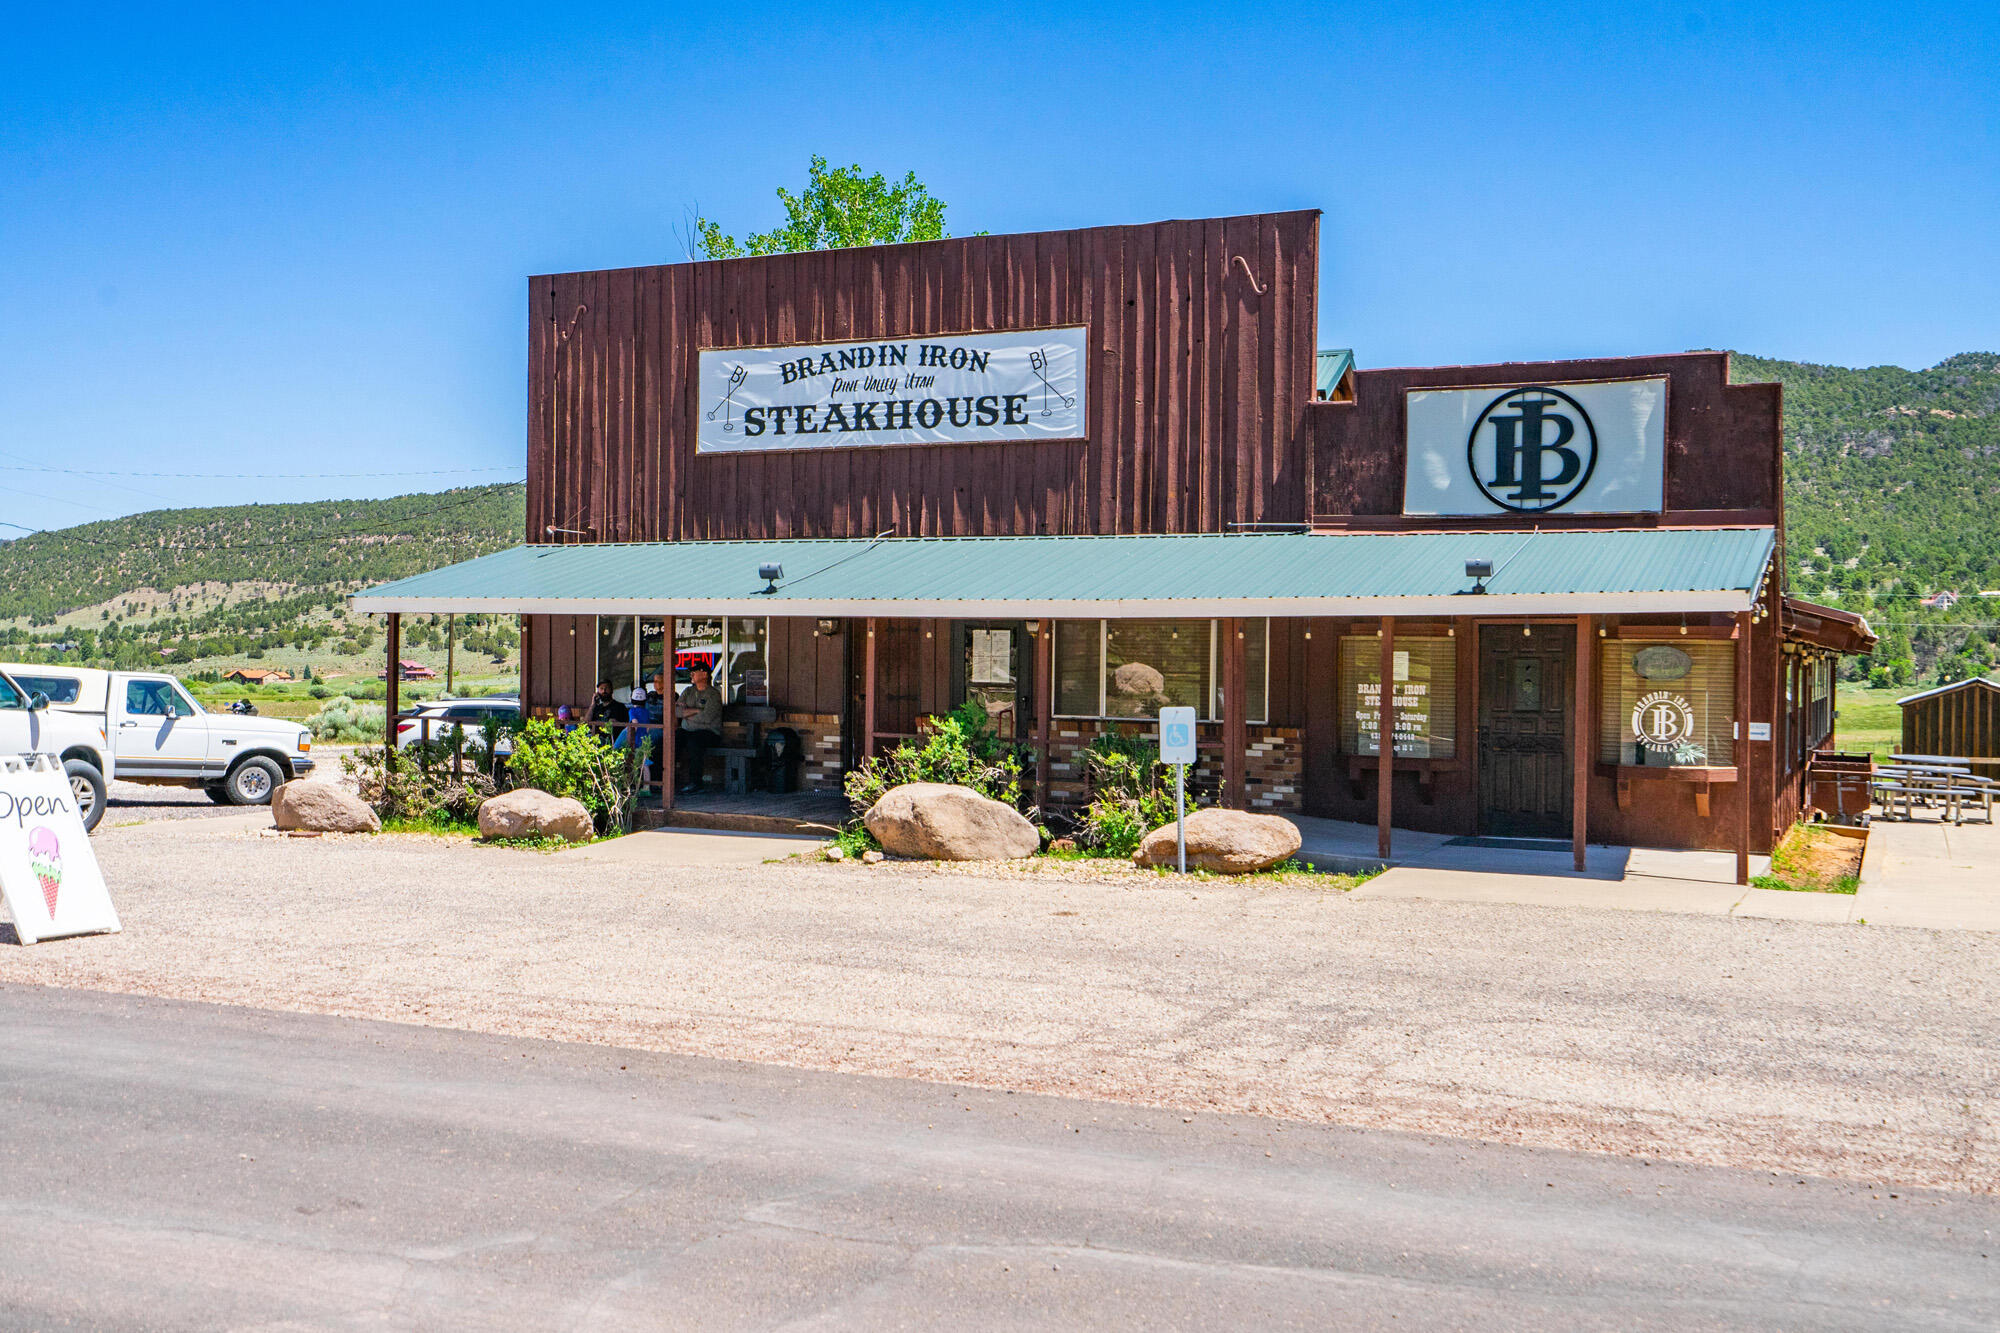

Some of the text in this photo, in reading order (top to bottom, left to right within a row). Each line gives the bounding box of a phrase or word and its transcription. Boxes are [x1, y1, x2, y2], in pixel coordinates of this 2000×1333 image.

[779, 344, 991, 385] BRANDIN IRON
[744, 393, 1029, 437] STEAKHOUSE
[642, 624, 660, 636] Ice
[695, 623, 721, 637] Shop
[690, 638, 713, 648] STORE
[1357, 683, 1427, 696] BRANN' IRON
[1364, 695, 1419, 707] STEHOUSE
[1400, 712, 1428, 723] Saturday
